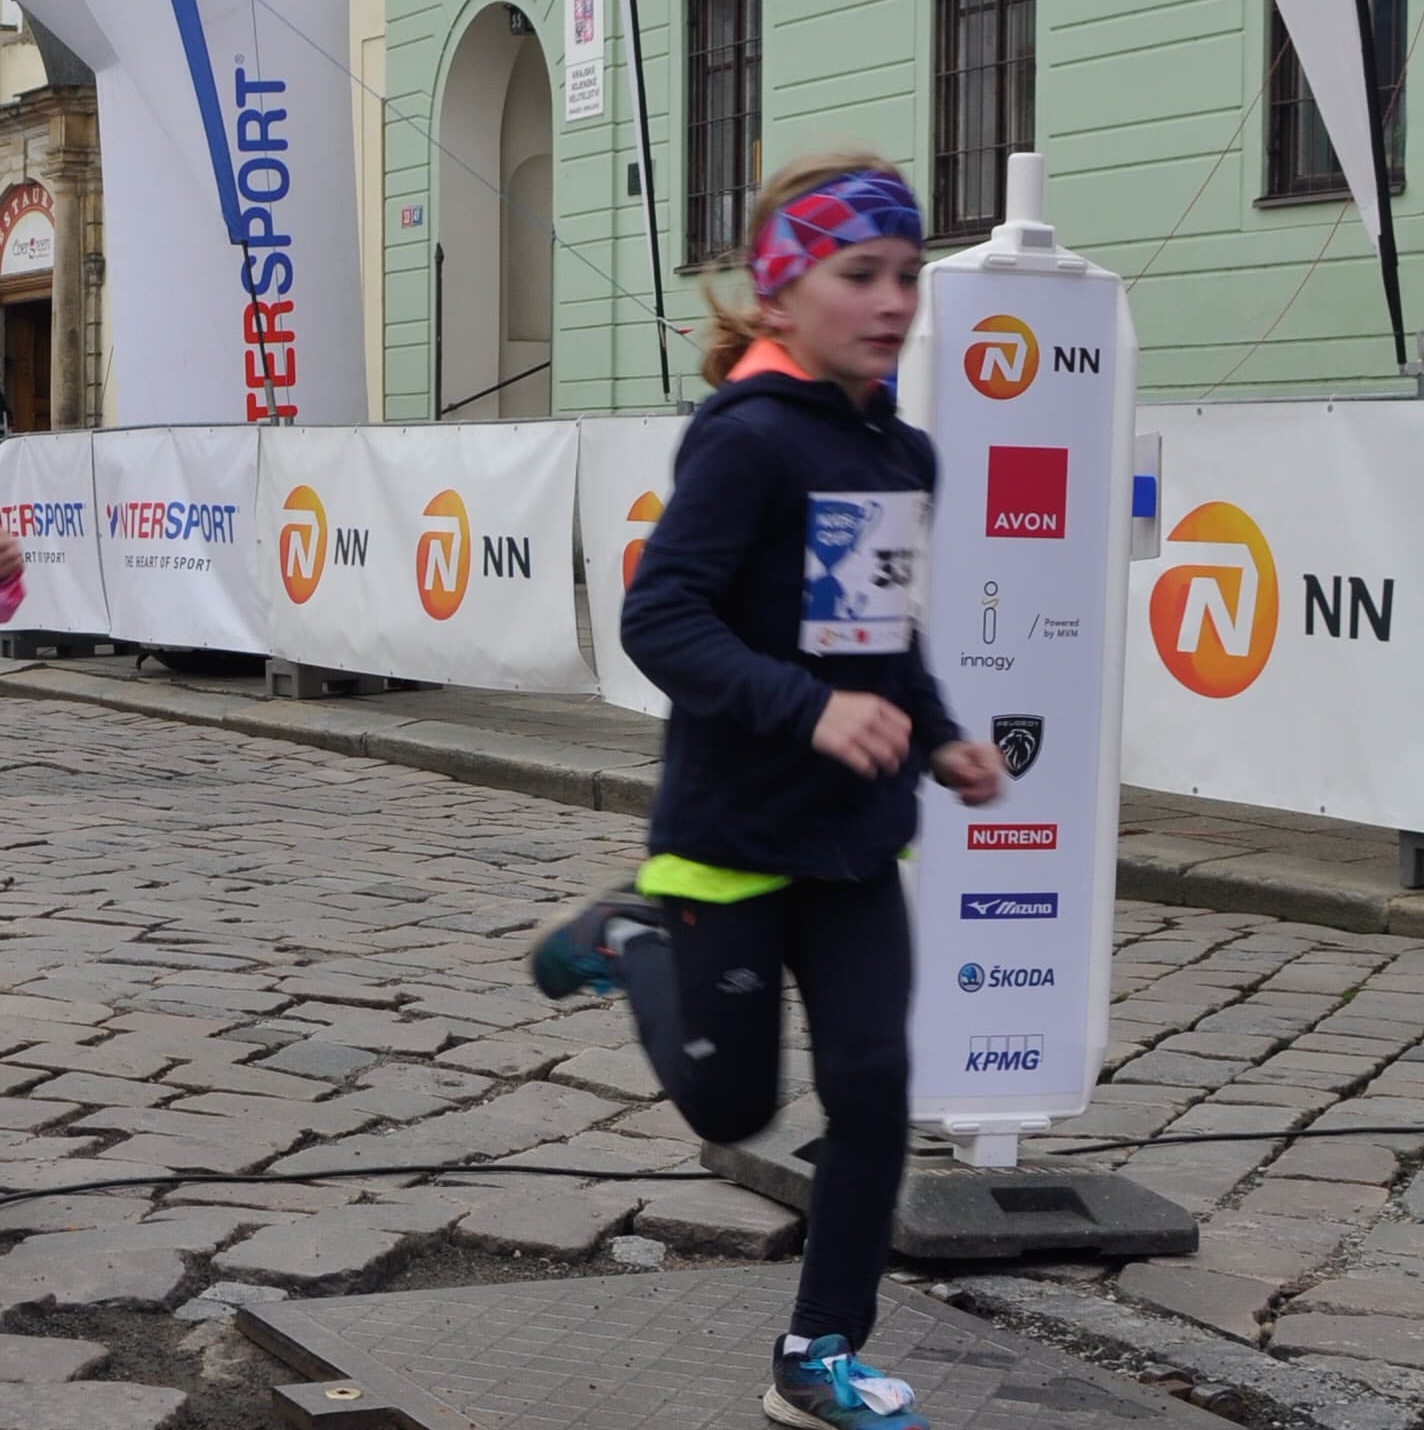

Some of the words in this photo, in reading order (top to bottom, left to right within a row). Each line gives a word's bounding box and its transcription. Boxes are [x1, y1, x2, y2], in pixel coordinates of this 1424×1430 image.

[234, 66, 298, 423] TERSPORT
[1053, 346, 1101, 374] NN
[119, 501, 235, 544] NTERSPORT
[994, 512, 1057, 531] AVON
[333, 527, 370, 568] NN
[482, 535, 532, 580] NN
[159, 556, 171, 569] OF
[173, 556, 212, 572] SPORT
[1303, 573, 1395, 643] NN
[1043, 628, 1055, 640] by
[960, 651, 1015, 672] innogy
[972, 830, 1053, 845] NUTREND
[987, 965, 1056, 988] ŠKODA
[964, 1048, 1041, 1072] KPMG
